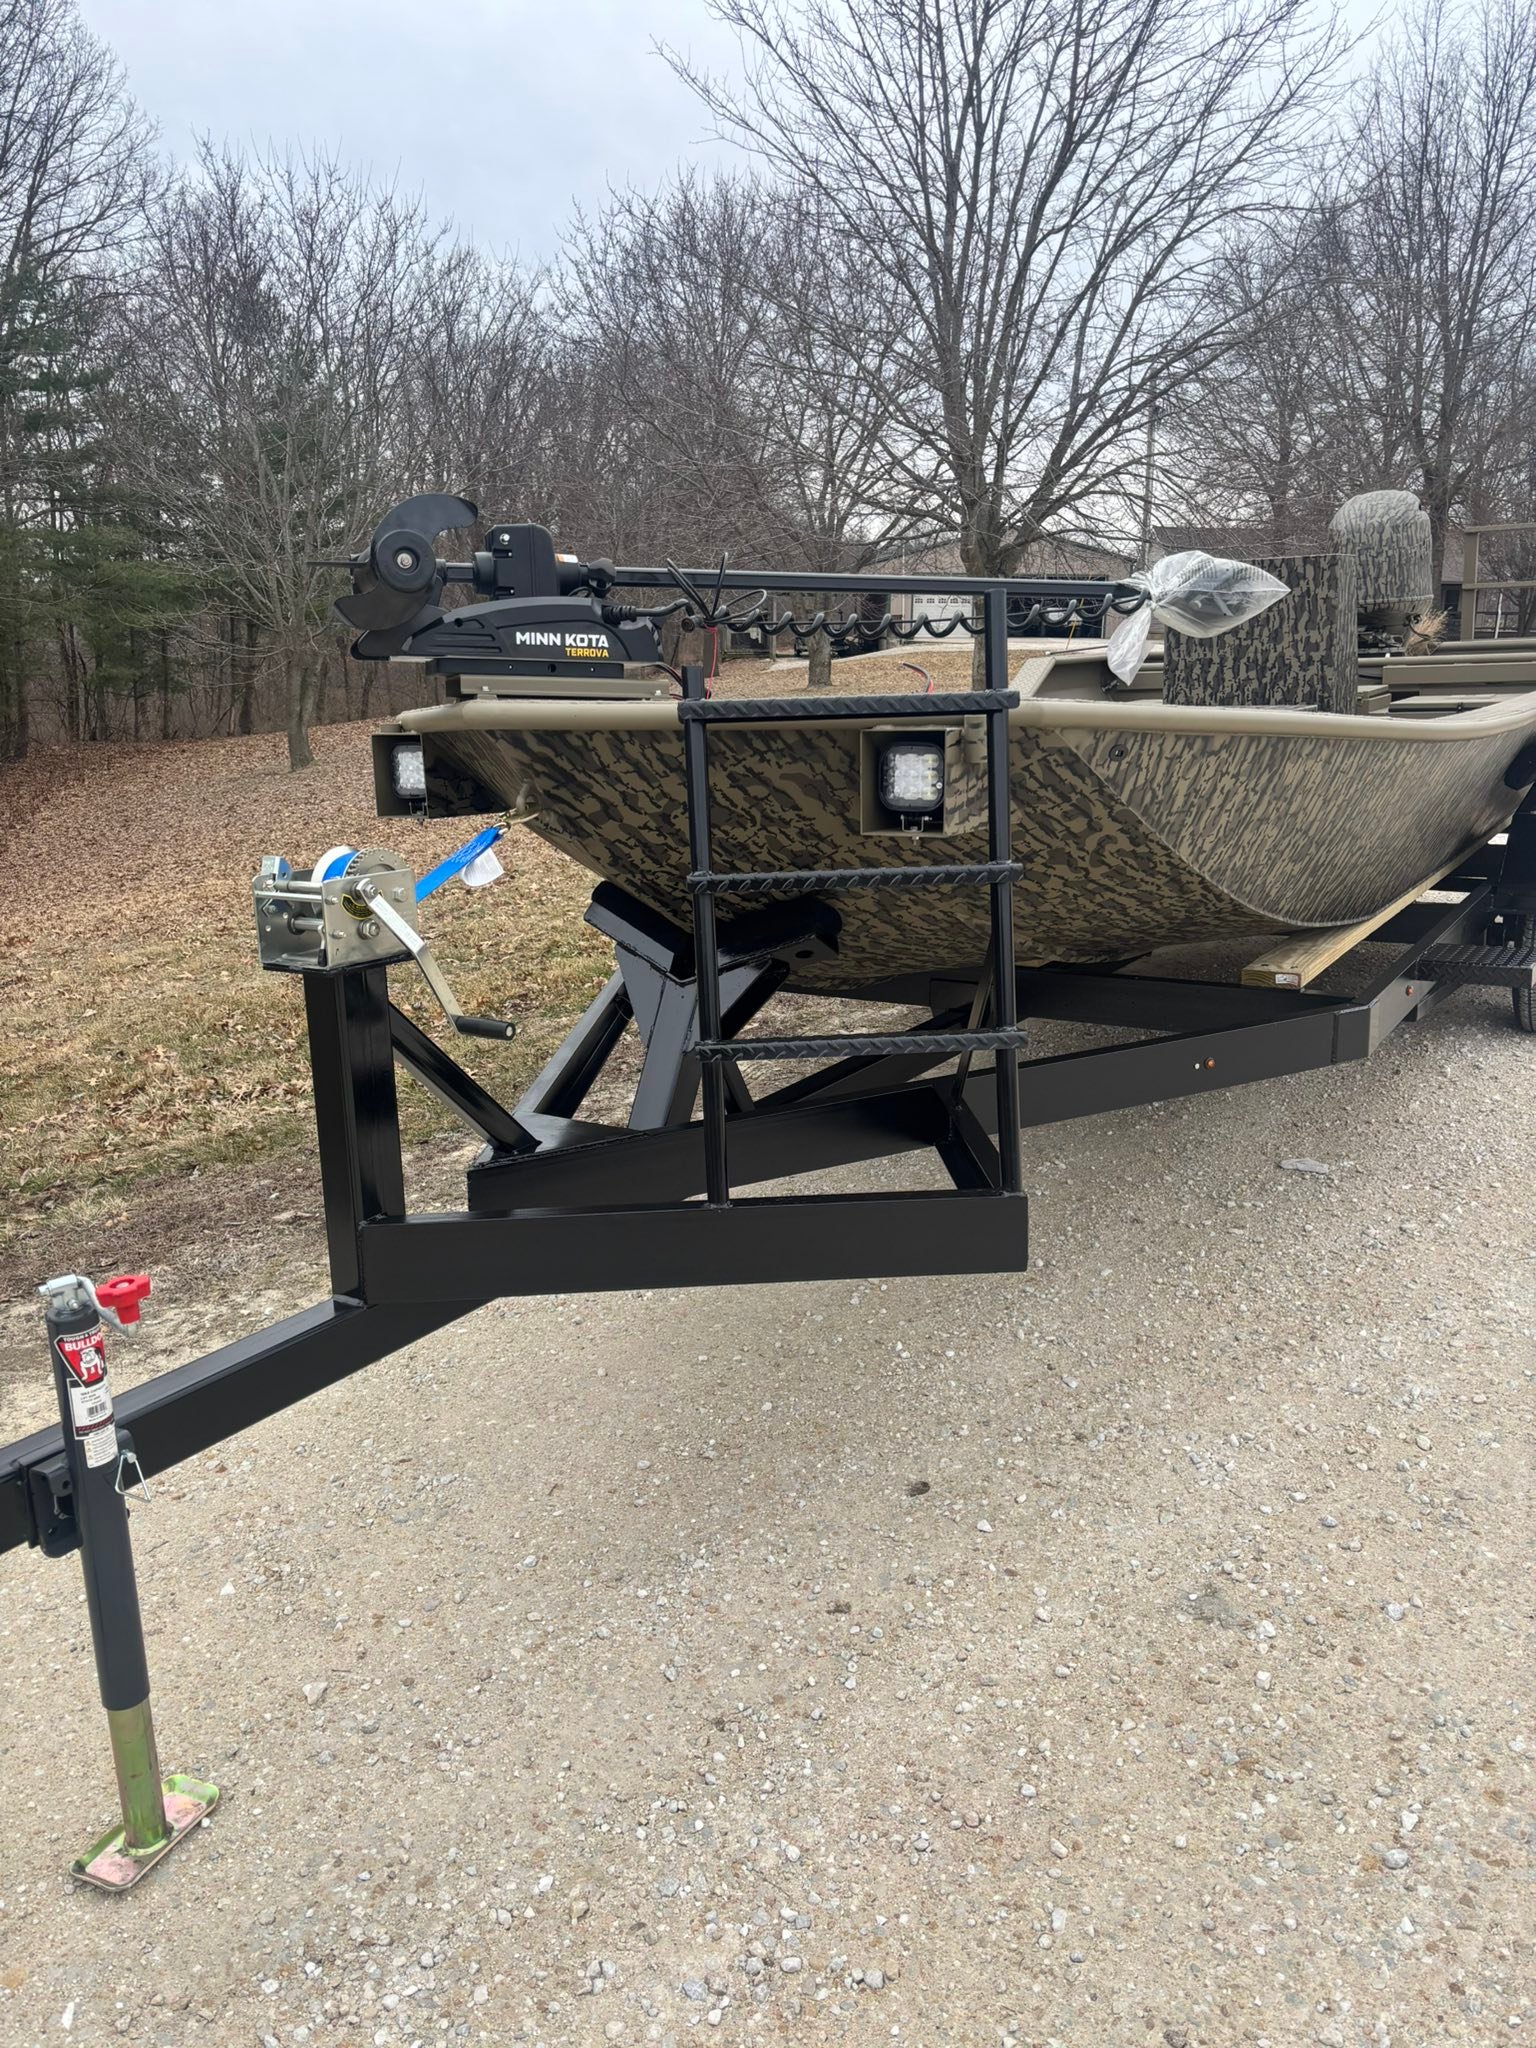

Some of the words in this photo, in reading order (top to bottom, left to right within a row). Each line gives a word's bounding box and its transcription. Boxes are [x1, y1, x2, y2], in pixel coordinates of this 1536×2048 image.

[515, 631, 562, 646] MINN
[565, 633, 609, 648] KOTA
[565, 647, 609, 658] TERROVA
